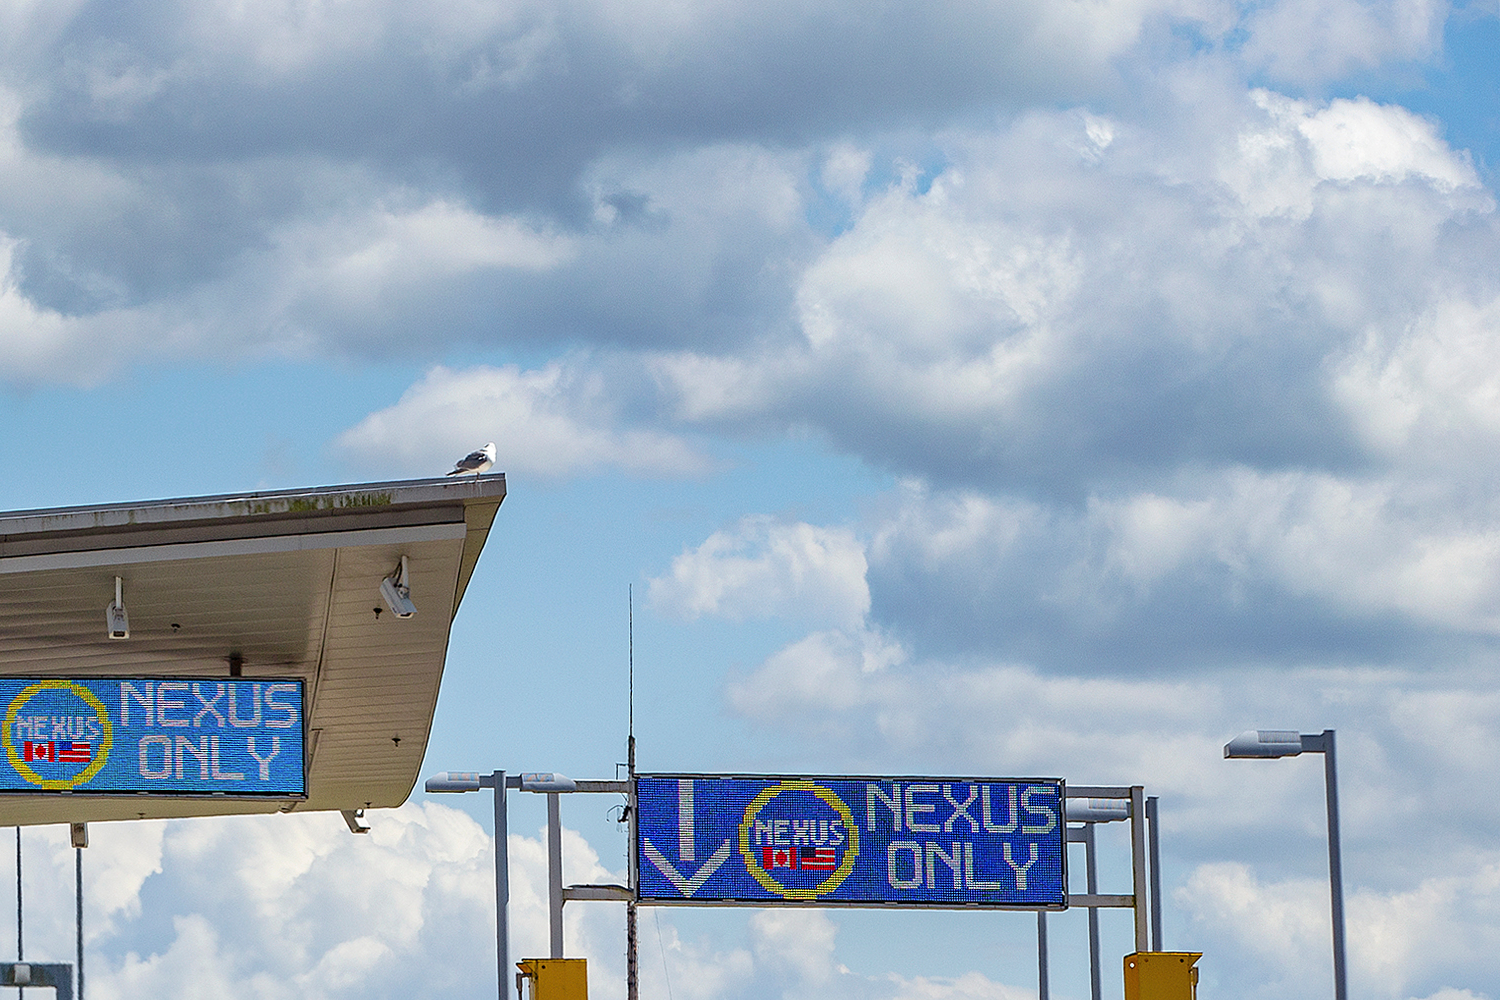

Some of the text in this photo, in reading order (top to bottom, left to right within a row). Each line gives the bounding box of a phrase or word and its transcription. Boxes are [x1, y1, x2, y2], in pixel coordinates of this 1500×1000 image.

[16, 715, 101, 740] NEXUS
[121, 681, 298, 728] NEXUS
[138, 735, 280, 781] ONLY
[865, 783, 1057, 834] NEXUS
[753, 819, 846, 846] NEXUS
[887, 840, 1039, 891] ONLY
